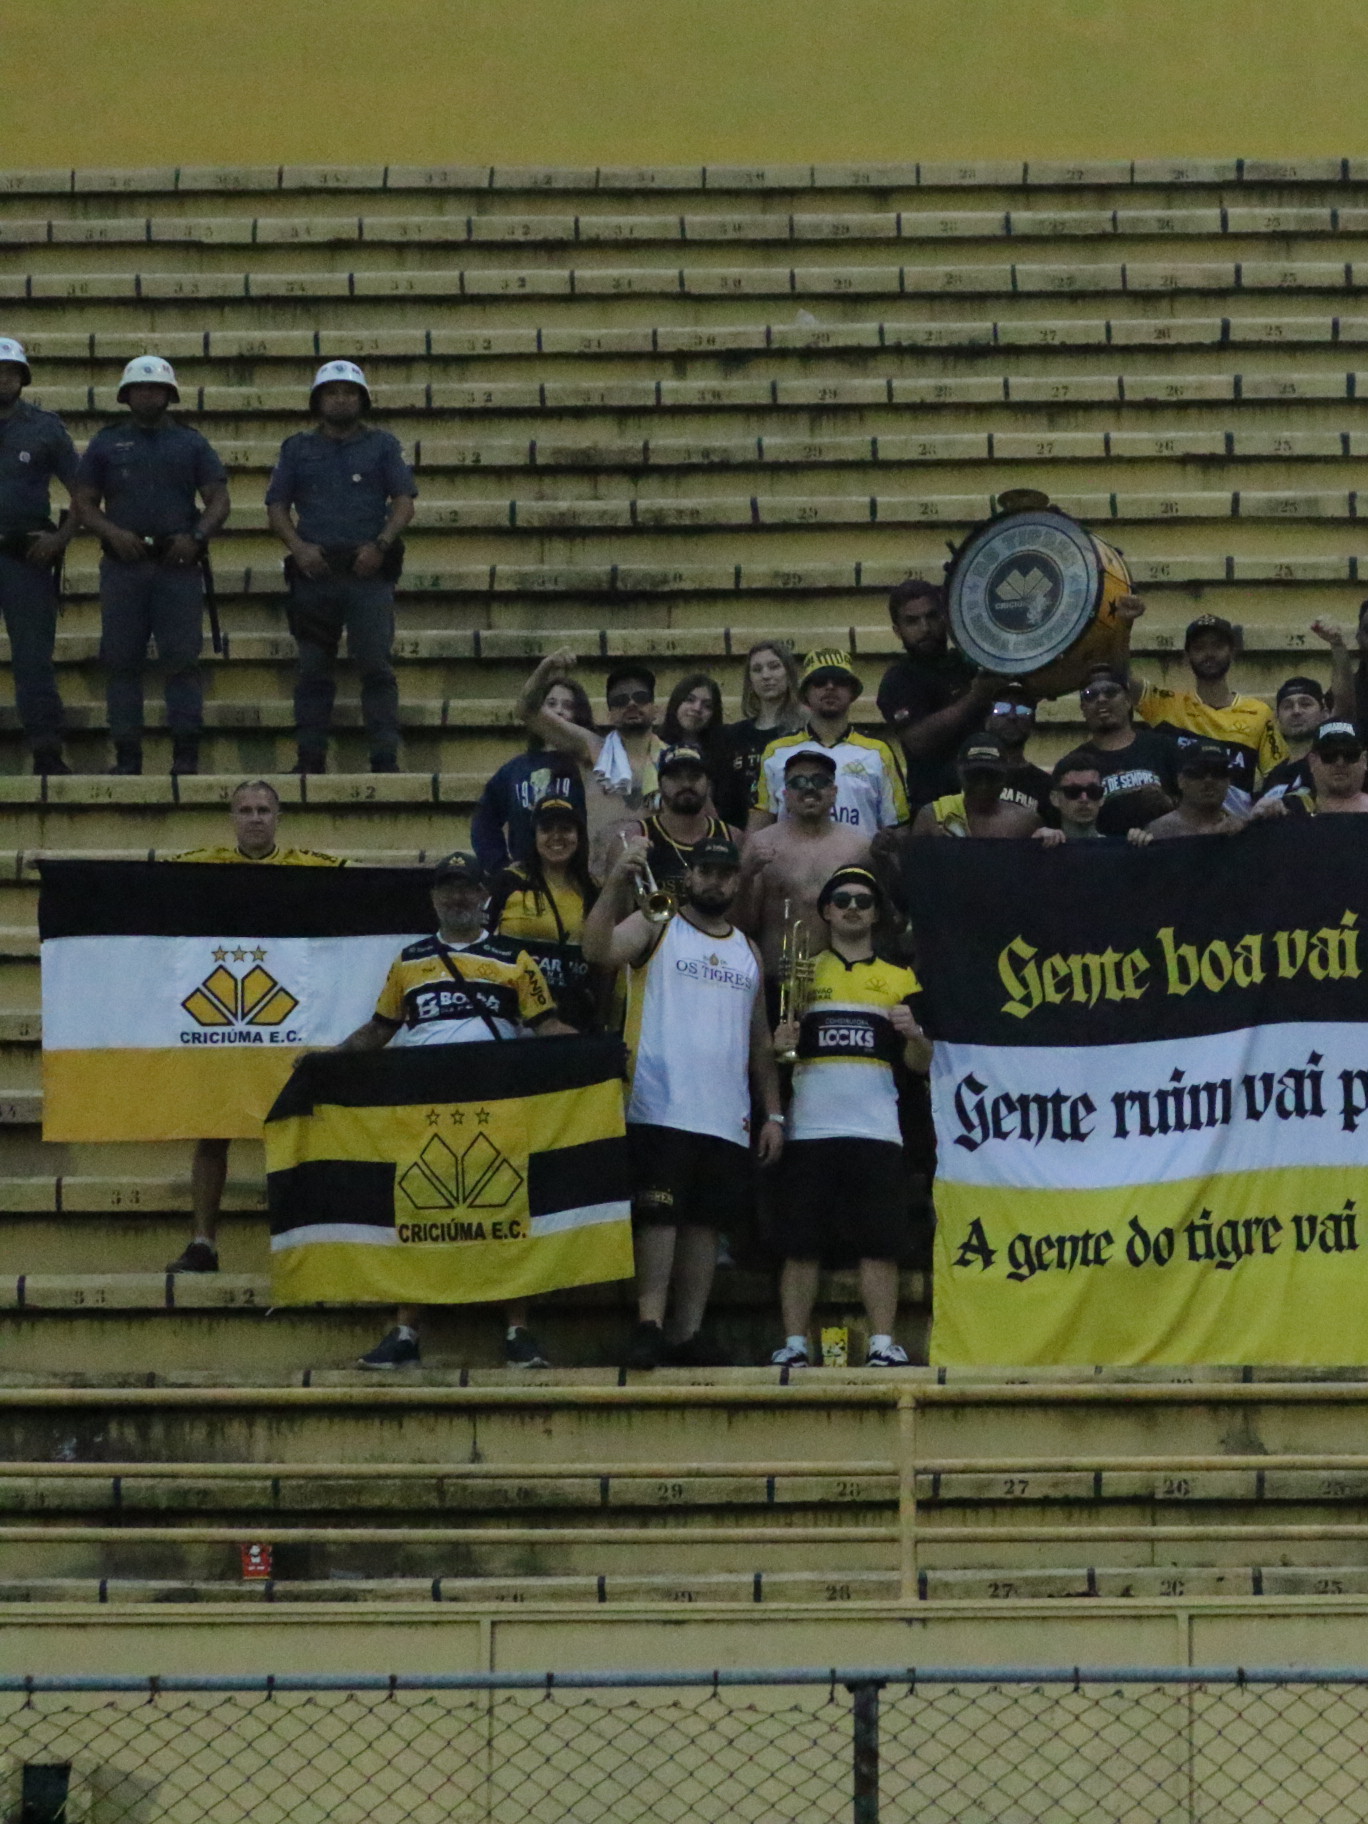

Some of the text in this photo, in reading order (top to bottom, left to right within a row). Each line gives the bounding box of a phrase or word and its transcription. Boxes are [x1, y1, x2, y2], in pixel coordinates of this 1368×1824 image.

[1052, 385, 1069, 398] 27
[998, 934, 1151, 1019] Gente
[1156, 926, 1266, 996] boa
[1272, 909, 1361, 981] vai
[675, 958, 752, 989] OS TIGRES
[180, 1028, 302, 1044] CRICIÚMA E.C.
[818, 1029, 875, 1048] LOCKS
[954, 1071, 1097, 1152] Gente
[1110, 1067, 1232, 1140] ruim
[1241, 1049, 1327, 1122] vai
[398, 1218, 527, 1243] CRICIÚMA E.C.
[952, 1216, 998, 1272] A
[1006, 1229, 1115, 1282] gente
[1125, 1215, 1175, 1268] do
[1183, 1207, 1284, 1271] tigre
[1290, 1199, 1360, 1253] vai
[658, 1484, 684, 1499] 29
[1004, 1479, 1028, 1495] 27
[1164, 1478, 1189, 1496] 26
[989, 1582, 1014, 1598] 27
